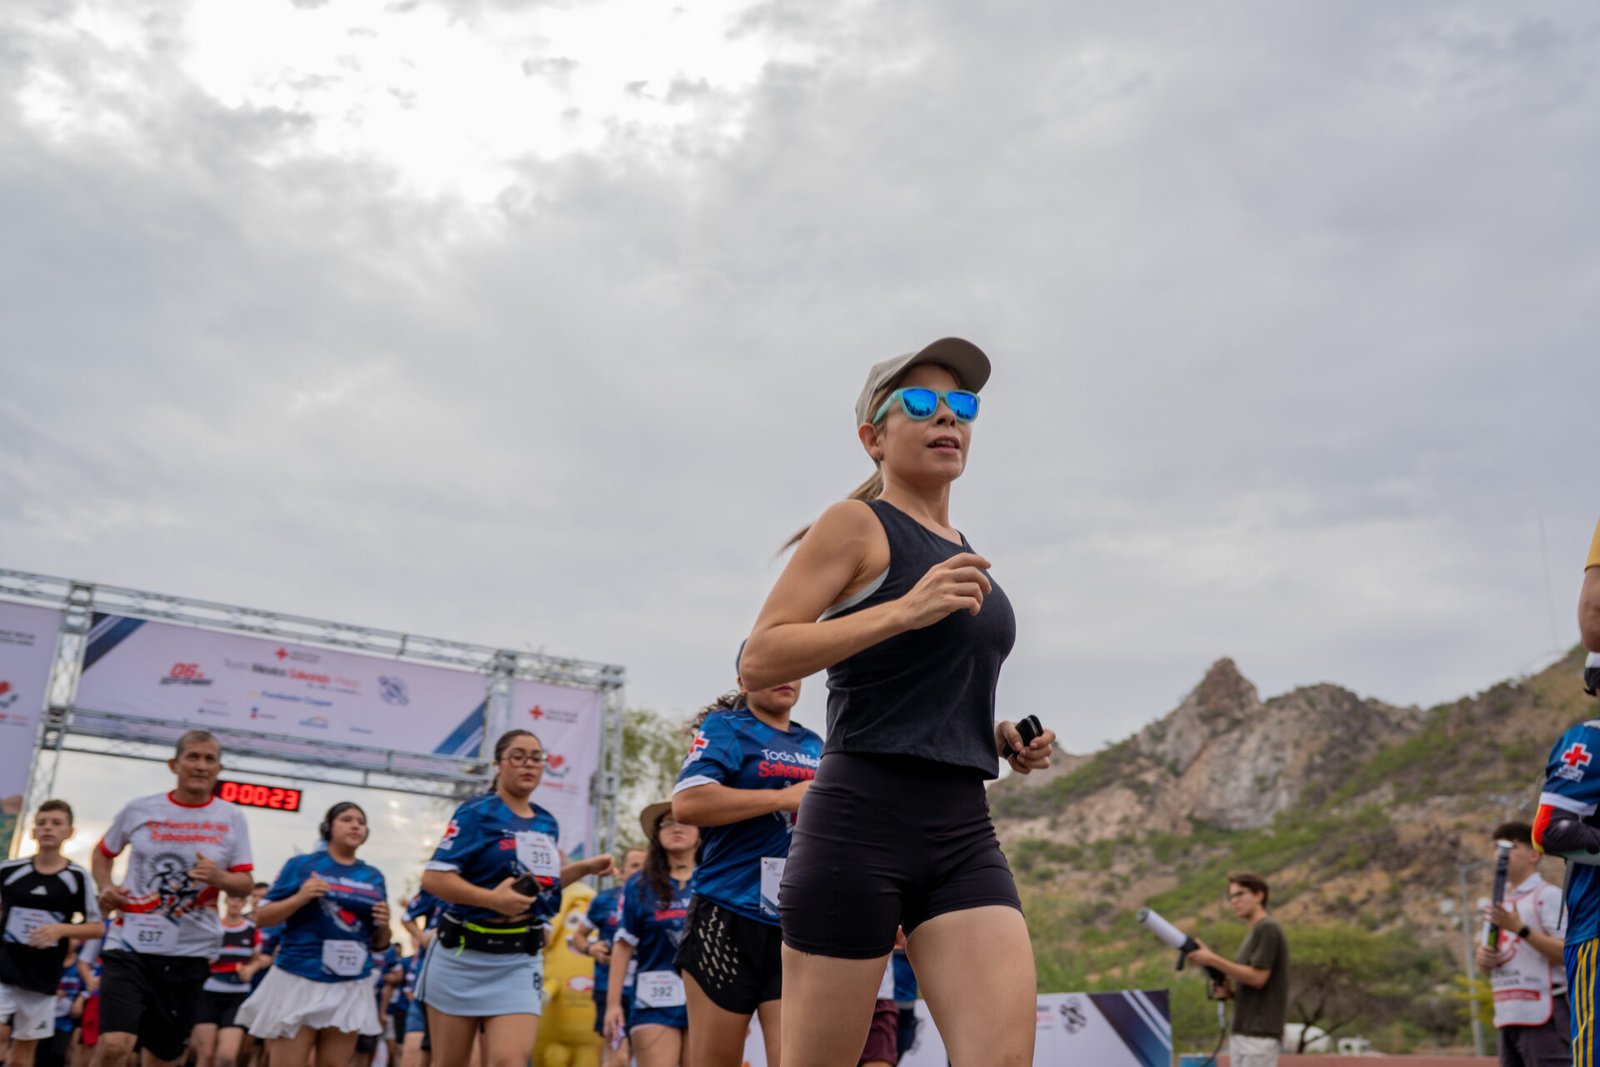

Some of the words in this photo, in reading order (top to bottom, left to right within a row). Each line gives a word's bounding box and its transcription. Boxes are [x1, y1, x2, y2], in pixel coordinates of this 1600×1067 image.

[761, 748, 796, 763] Todo
[532, 851, 551, 865] 313
[137, 930, 163, 943] 637
[651, 986, 673, 998] 392
